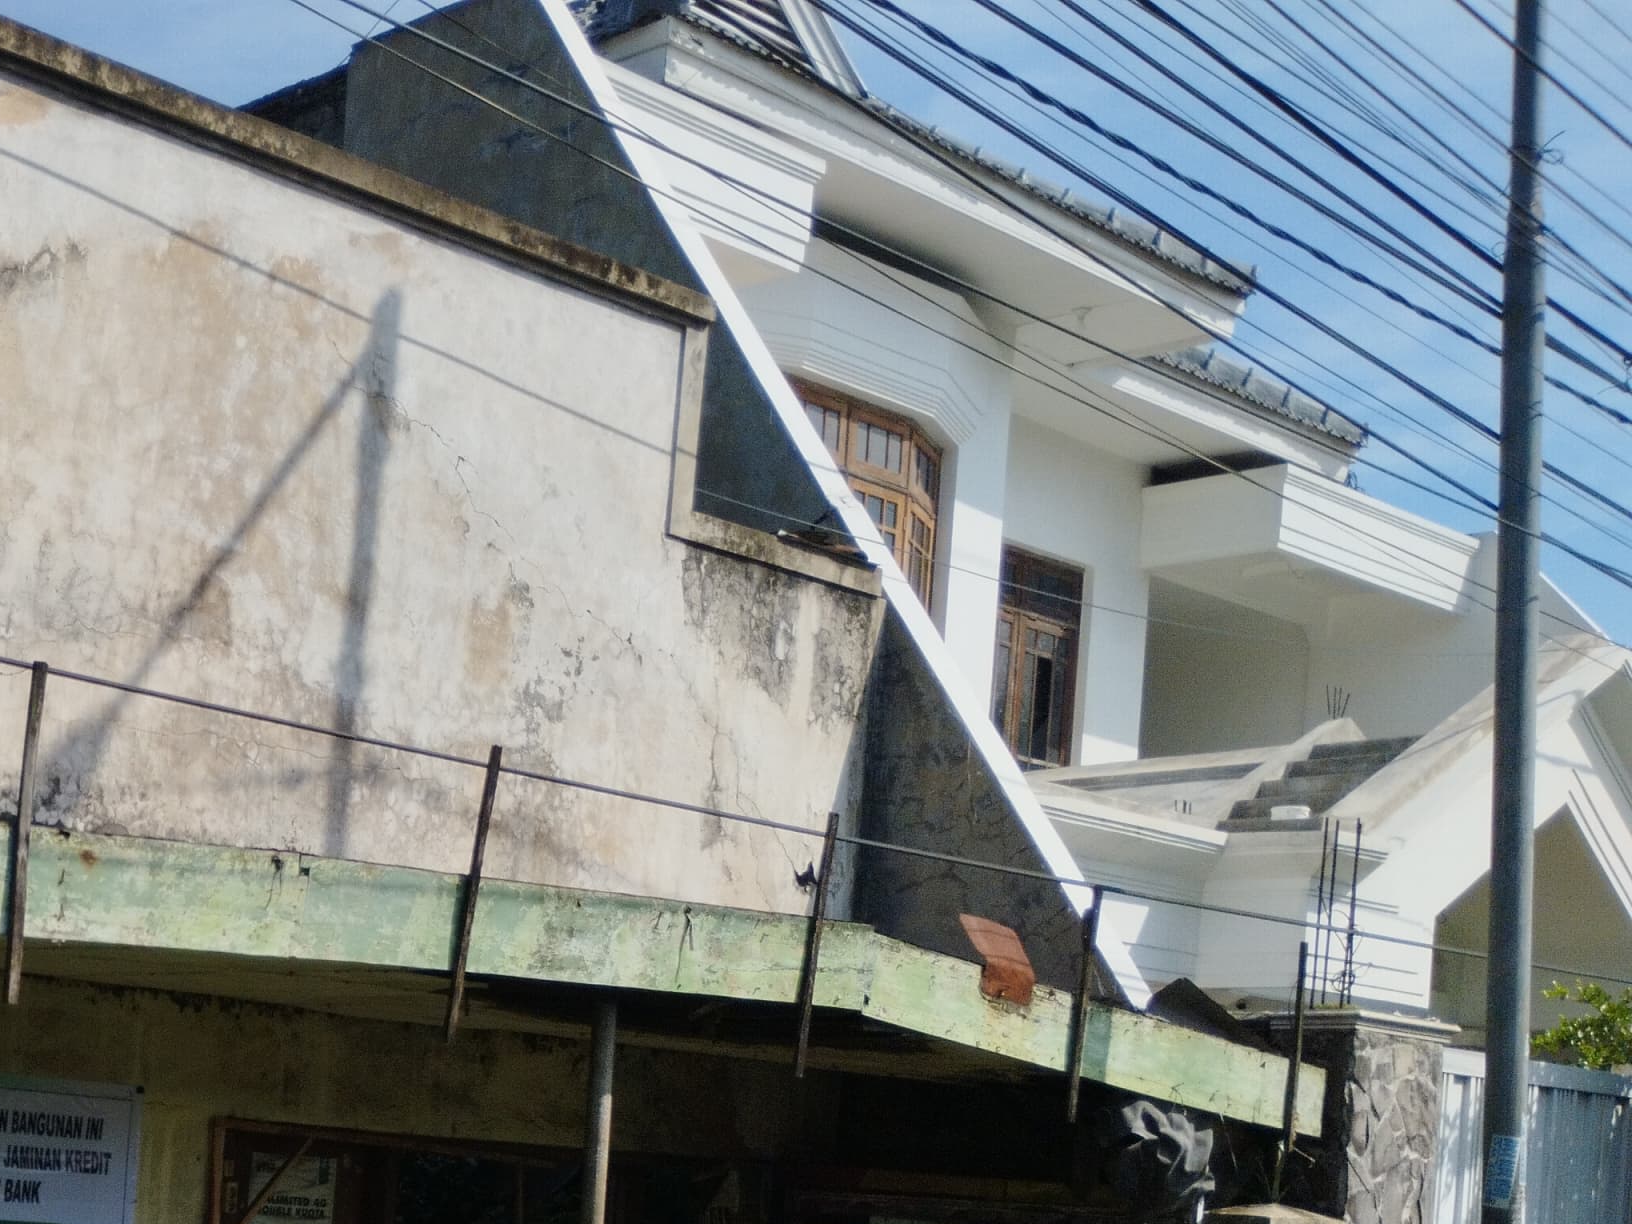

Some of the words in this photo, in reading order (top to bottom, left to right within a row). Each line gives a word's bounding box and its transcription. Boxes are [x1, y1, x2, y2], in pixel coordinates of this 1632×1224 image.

[11, 1110, 82, 1138] BANGUNAN
[85, 1117, 104, 1140] INI
[3, 1146, 62, 1172] JAMINAN
[66, 1151, 112, 1176] KREDIT
[4, 1179, 42, 1204] BANK
